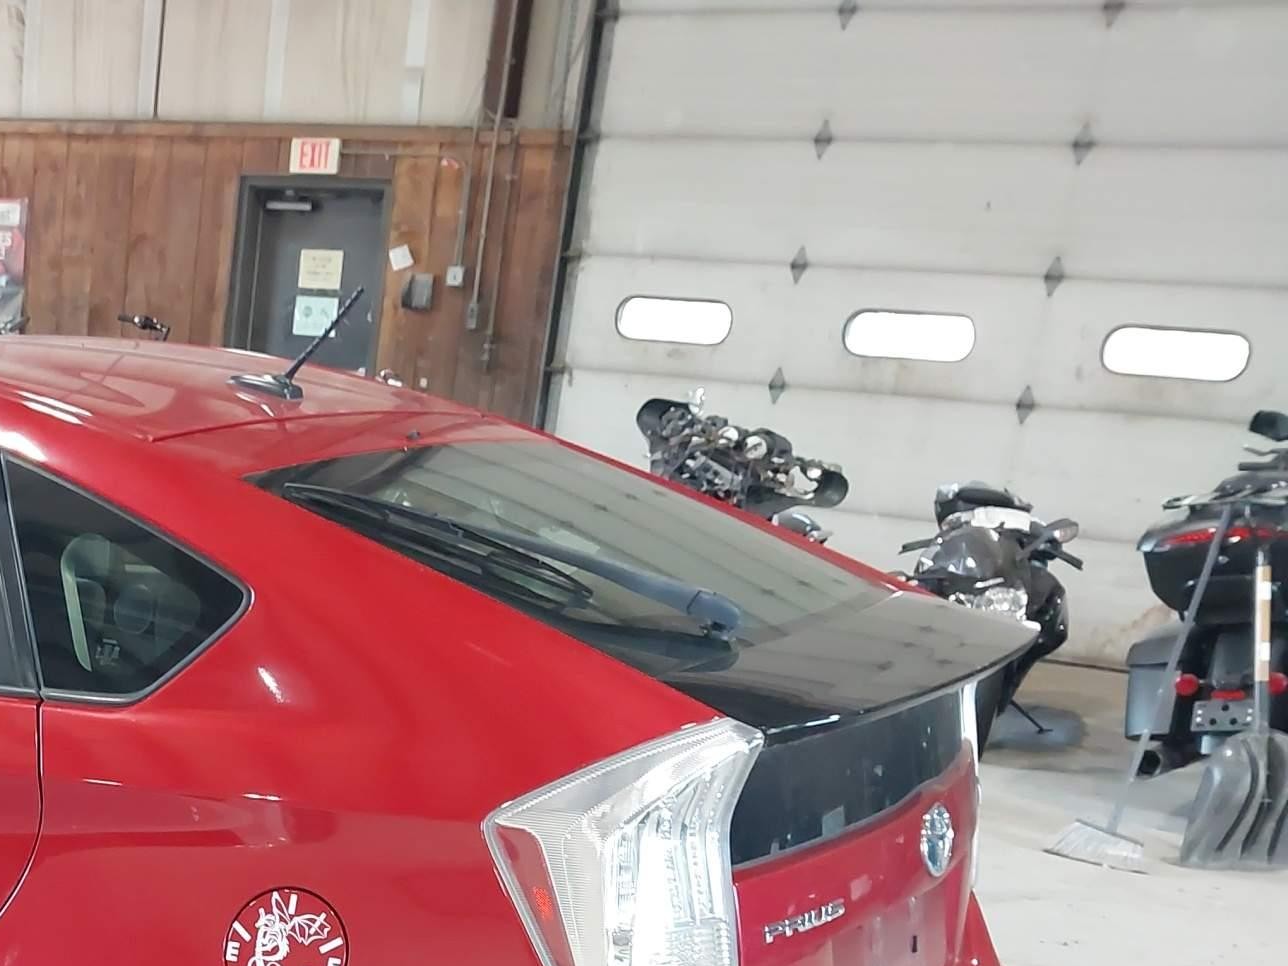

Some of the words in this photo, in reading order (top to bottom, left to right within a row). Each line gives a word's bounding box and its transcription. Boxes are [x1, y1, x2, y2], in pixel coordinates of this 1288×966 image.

[299, 141, 331, 169] EXIT
[764, 898, 846, 944] PRIUS
[225, 940, 241, 963] E
